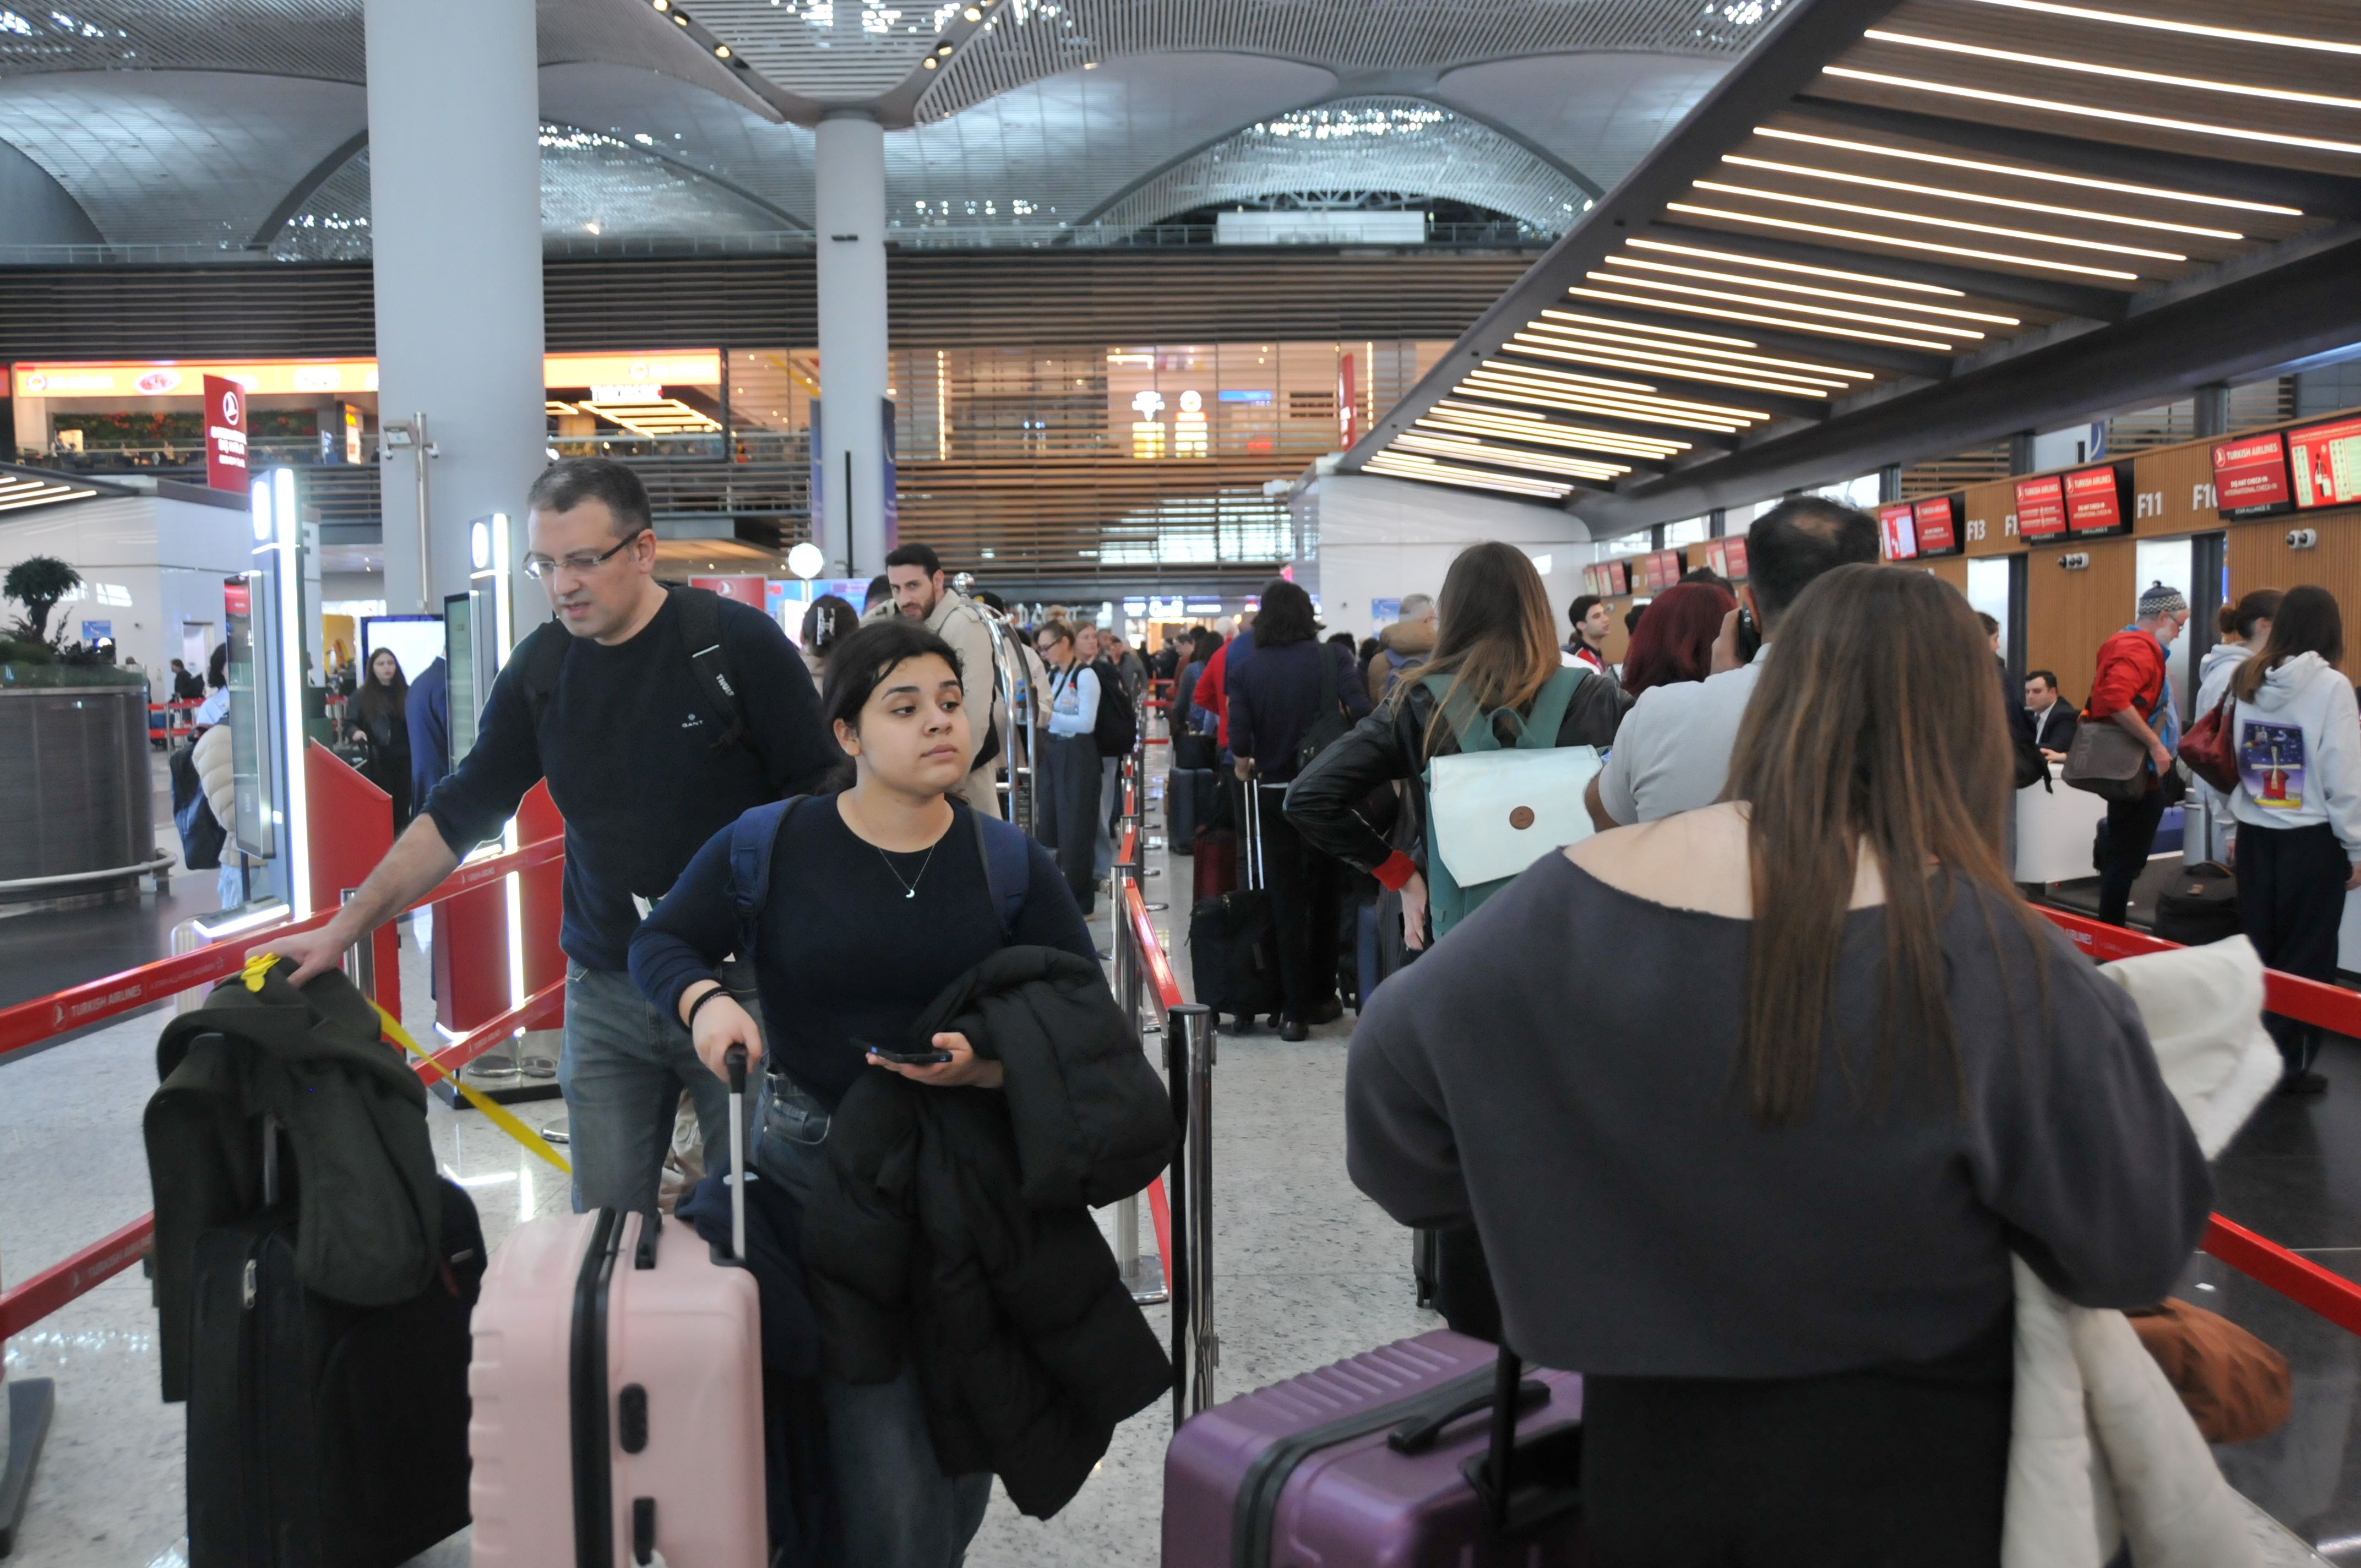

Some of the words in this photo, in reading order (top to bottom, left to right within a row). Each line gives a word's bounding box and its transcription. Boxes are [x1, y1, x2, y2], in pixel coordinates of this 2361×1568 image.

[2226, 448, 2251, 460] TURKISH
[2251, 443, 2277, 456] AIRLINES
[2137, 491, 2162, 519] F11
[1967, 519, 1985, 542] F13
[2005, 514, 2020, 537] F1
[70, 997, 106, 1017] TURKISH
[108, 984, 142, 1006] AIRLINES
